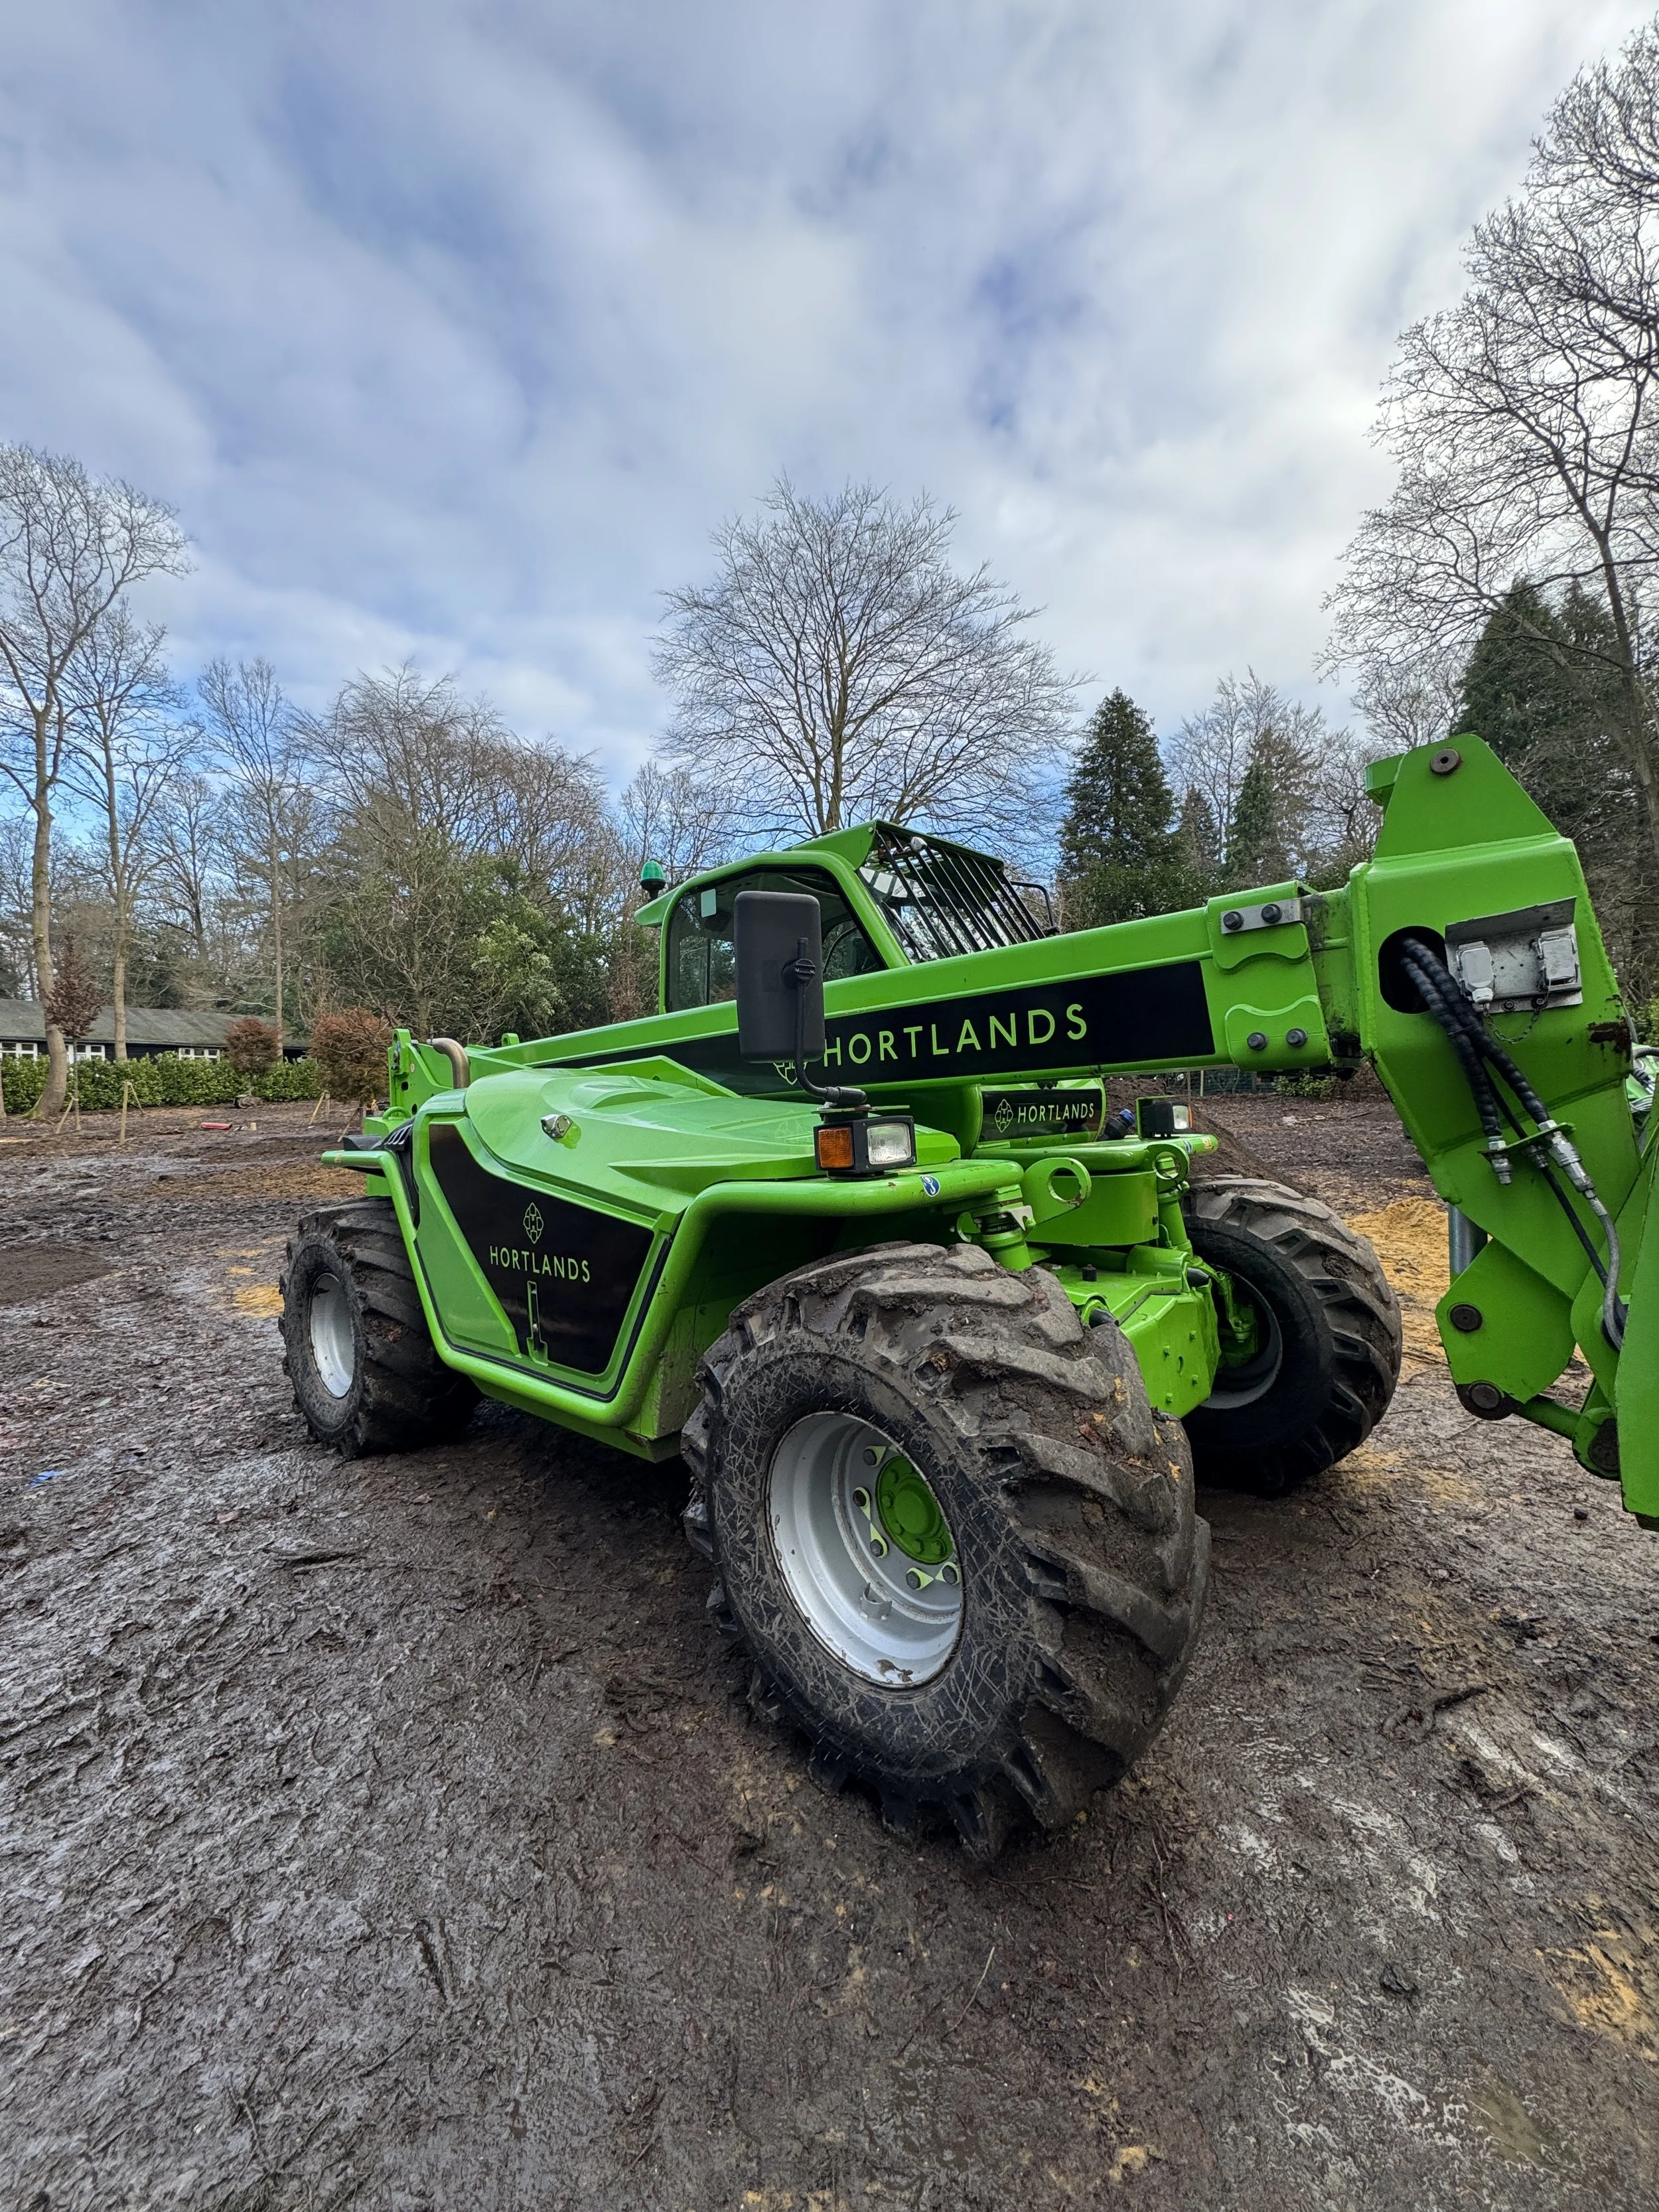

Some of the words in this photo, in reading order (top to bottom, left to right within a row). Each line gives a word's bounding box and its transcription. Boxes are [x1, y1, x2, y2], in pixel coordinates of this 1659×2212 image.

[824, 1003, 1087, 1067] HORTLANDS
[1017, 1102, 1094, 1124] HORTLANDS
[489, 1245, 591, 1284] HORTLANDS
